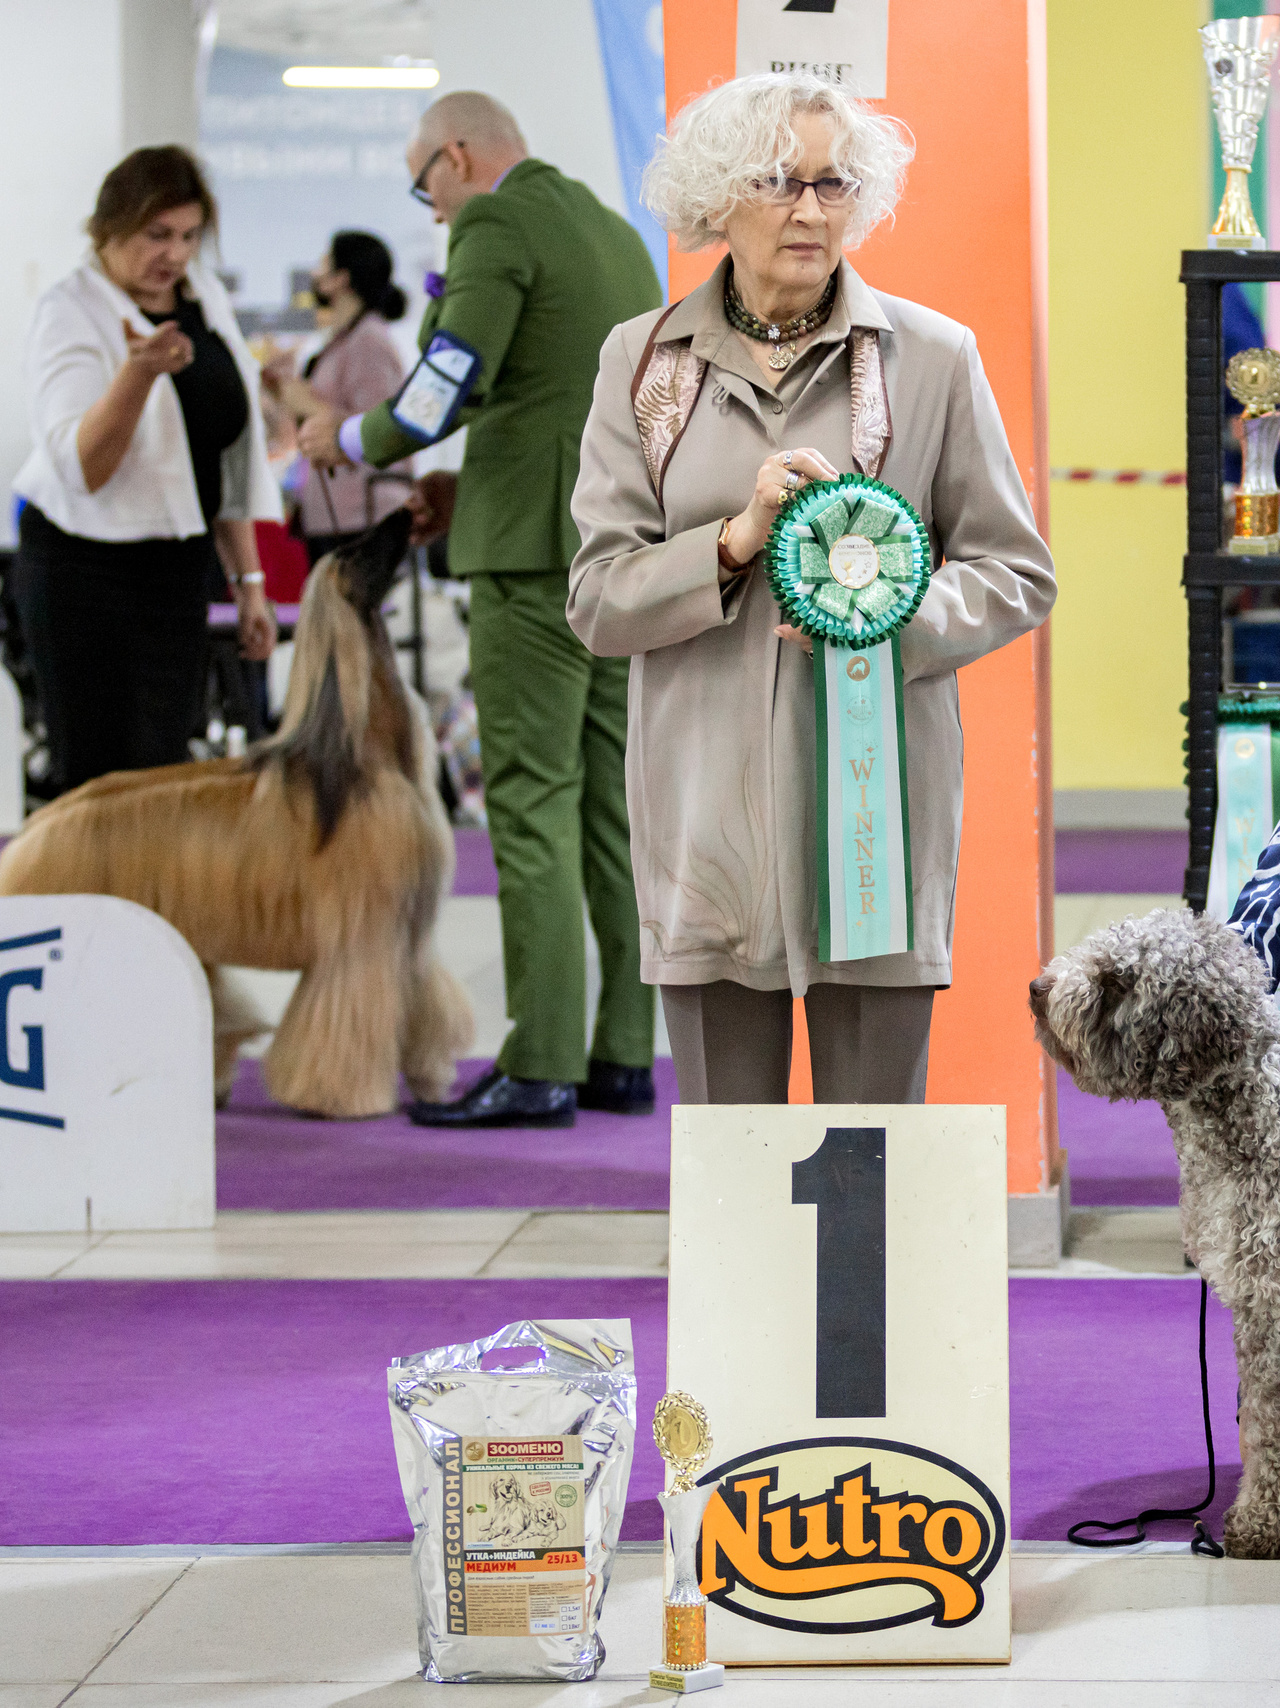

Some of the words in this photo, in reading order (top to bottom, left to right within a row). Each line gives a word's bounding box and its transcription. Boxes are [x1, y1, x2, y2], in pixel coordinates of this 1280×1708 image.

[849, 757, 878, 915] WINNER
[792, 1127, 887, 1418] 1
[489, 1443, 562, 1455] ЗООМЕНЮ
[445, 1442, 465, 1632] ПРОФЕССИОНАЛ
[466, 1562, 517, 1573] МЕДИУМ
[547, 1554, 578, 1564] 25/13
[698, 1474, 983, 1597] Nutro
